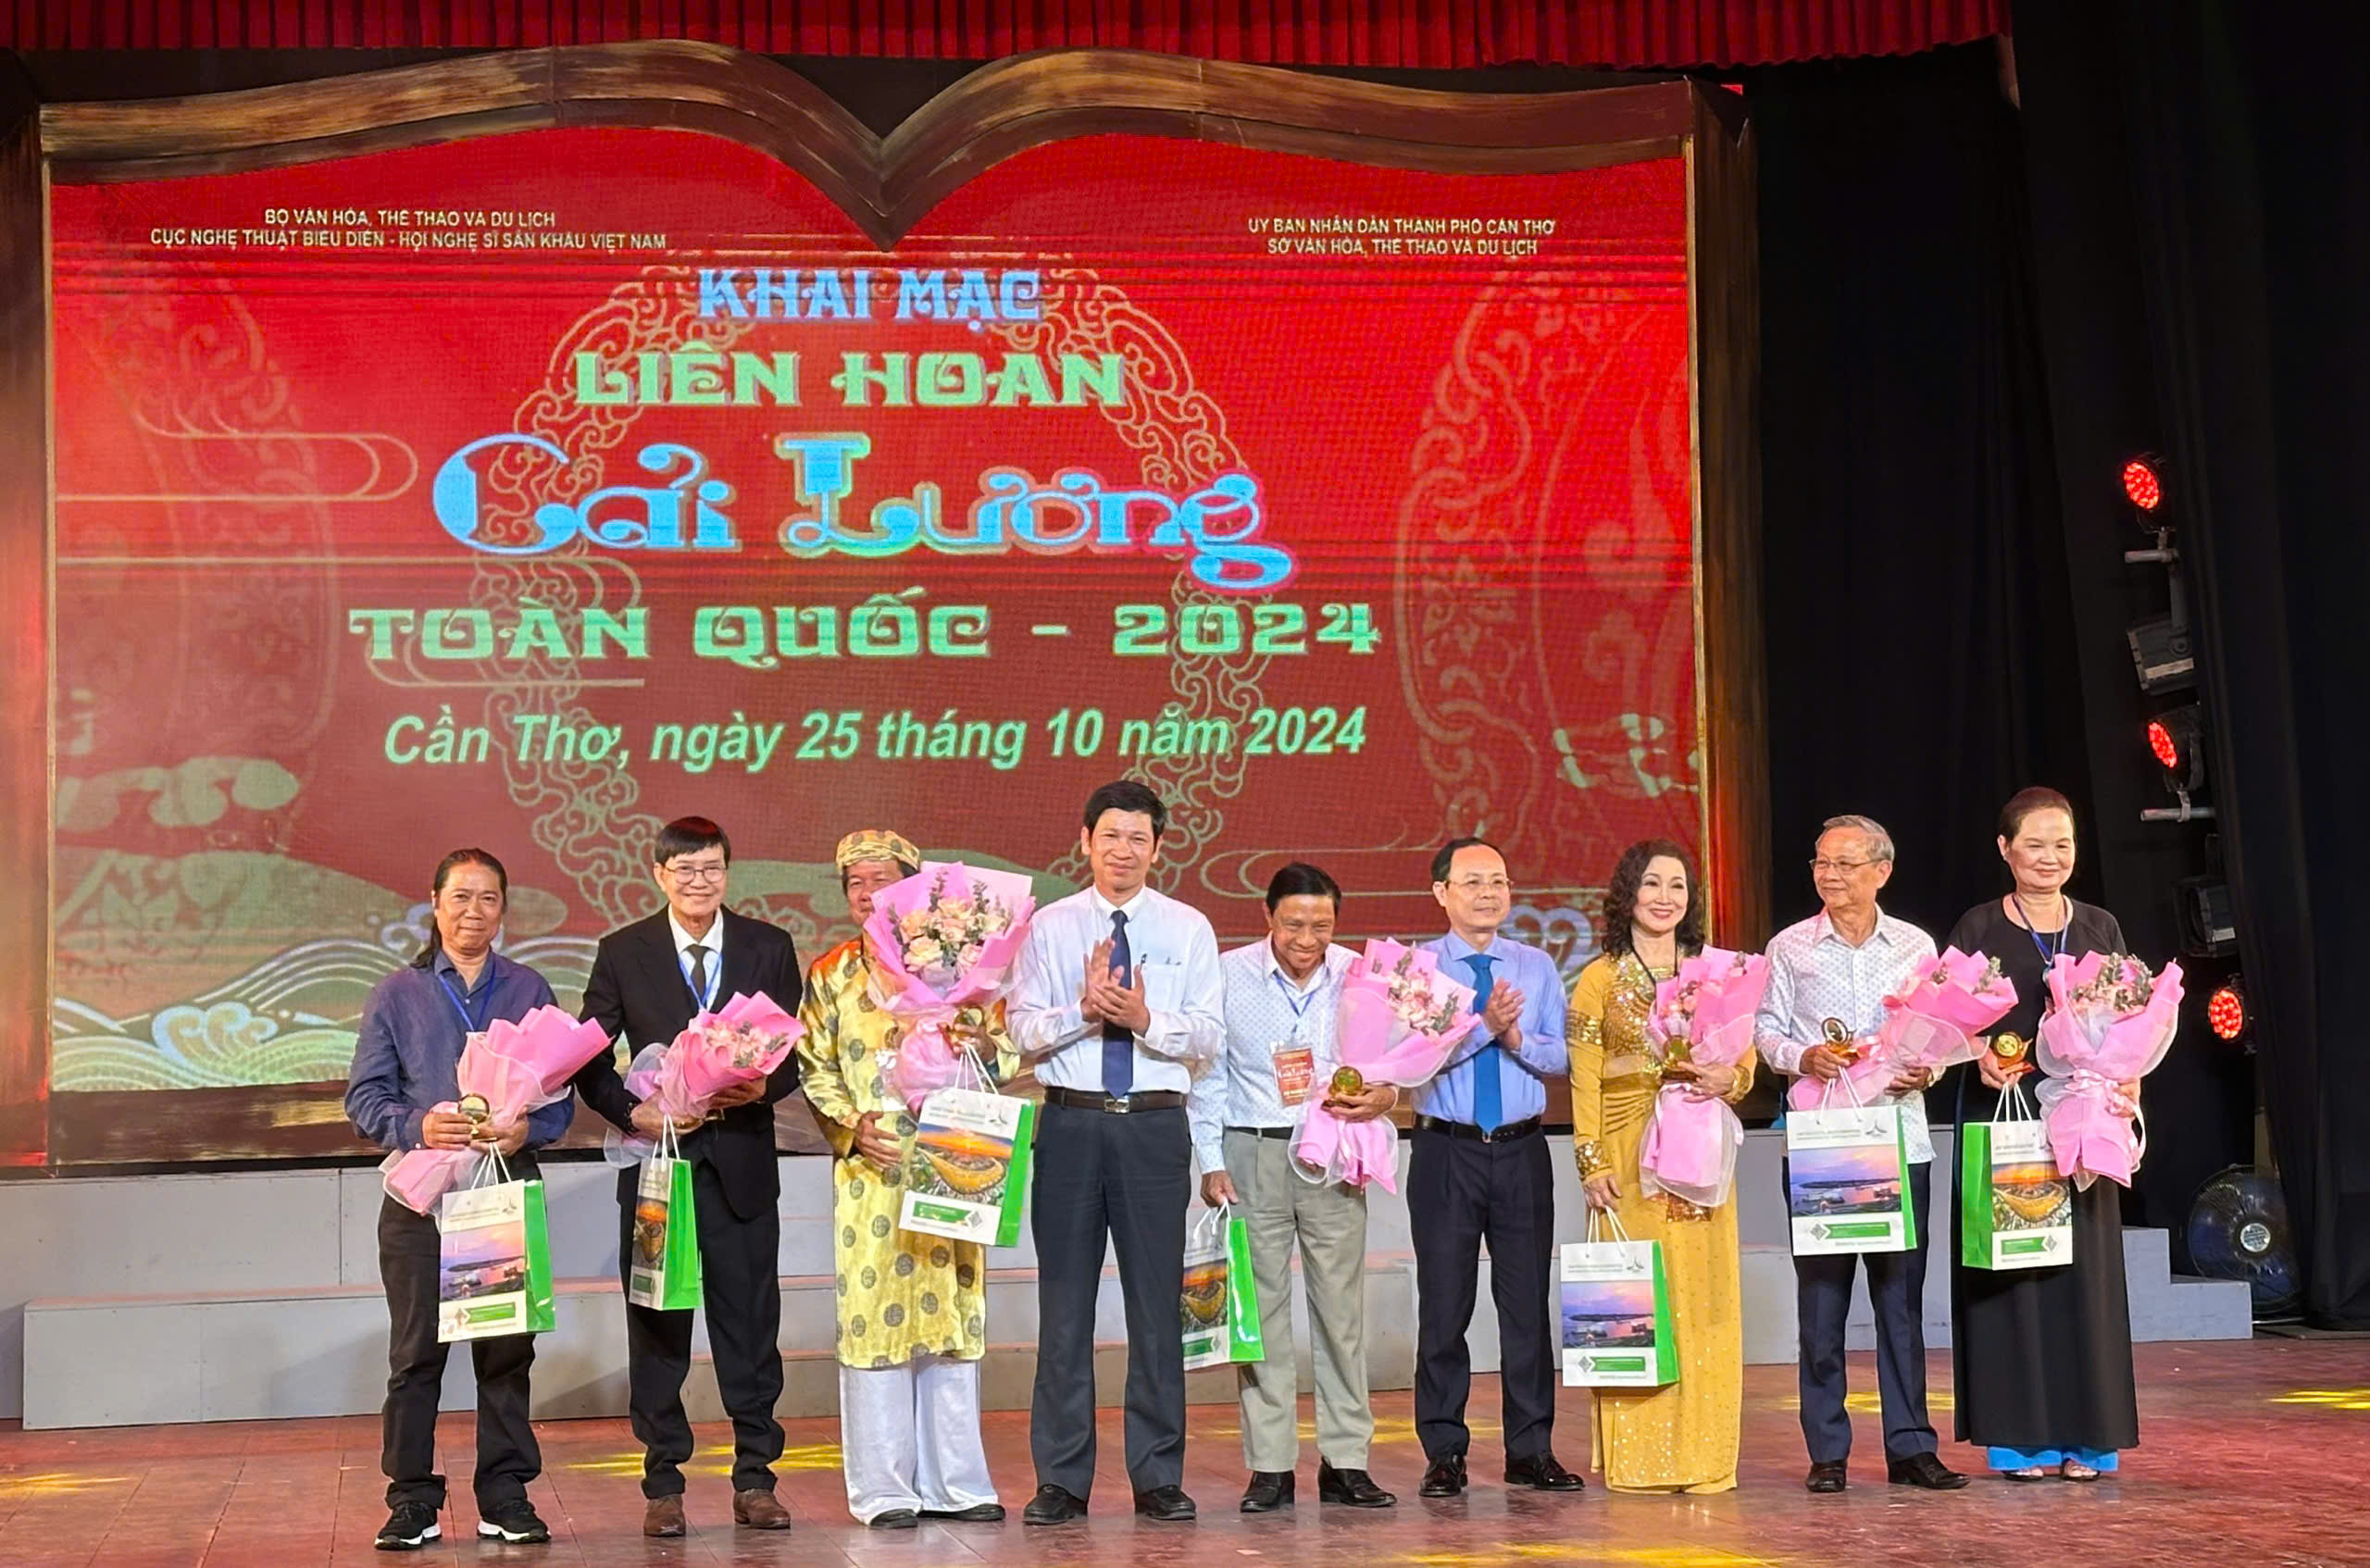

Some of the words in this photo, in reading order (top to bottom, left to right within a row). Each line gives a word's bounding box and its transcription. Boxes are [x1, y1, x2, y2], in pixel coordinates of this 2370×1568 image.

[151, 229, 185, 249] CỤC
[630, 233, 666, 249] NAM
[414, 210, 460, 227] THAO
[491, 211, 513, 227] DU
[1273, 218, 1306, 233] BAN
[1405, 238, 1448, 255] THAO
[1477, 239, 1499, 255] DU
[1502, 239, 1538, 259] LỊCH
[698, 268, 872, 320] KHAI
[894, 268, 1041, 332] MẠC
[574, 341, 800, 407] LIÊN
[830, 351, 1129, 407] HOAN
[431, 431, 742, 555] Cải
[776, 431, 1293, 593] Lương
[348, 597, 650, 659] TOÀN
[692, 587, 991, 668] QUỐC
[1031, 625, 1070, 636] -
[1112, 602, 1381, 655] 2024
[384, 704, 491, 764] Cần
[513, 714, 630, 770] Thơ,
[650, 712, 784, 774] ngày
[796, 711, 864, 760] 25
[877, 709, 1028, 771] tháng
[1046, 708, 1105, 757] 10
[1117, 706, 1231, 757] năm
[1245, 706, 1367, 755] 2024
